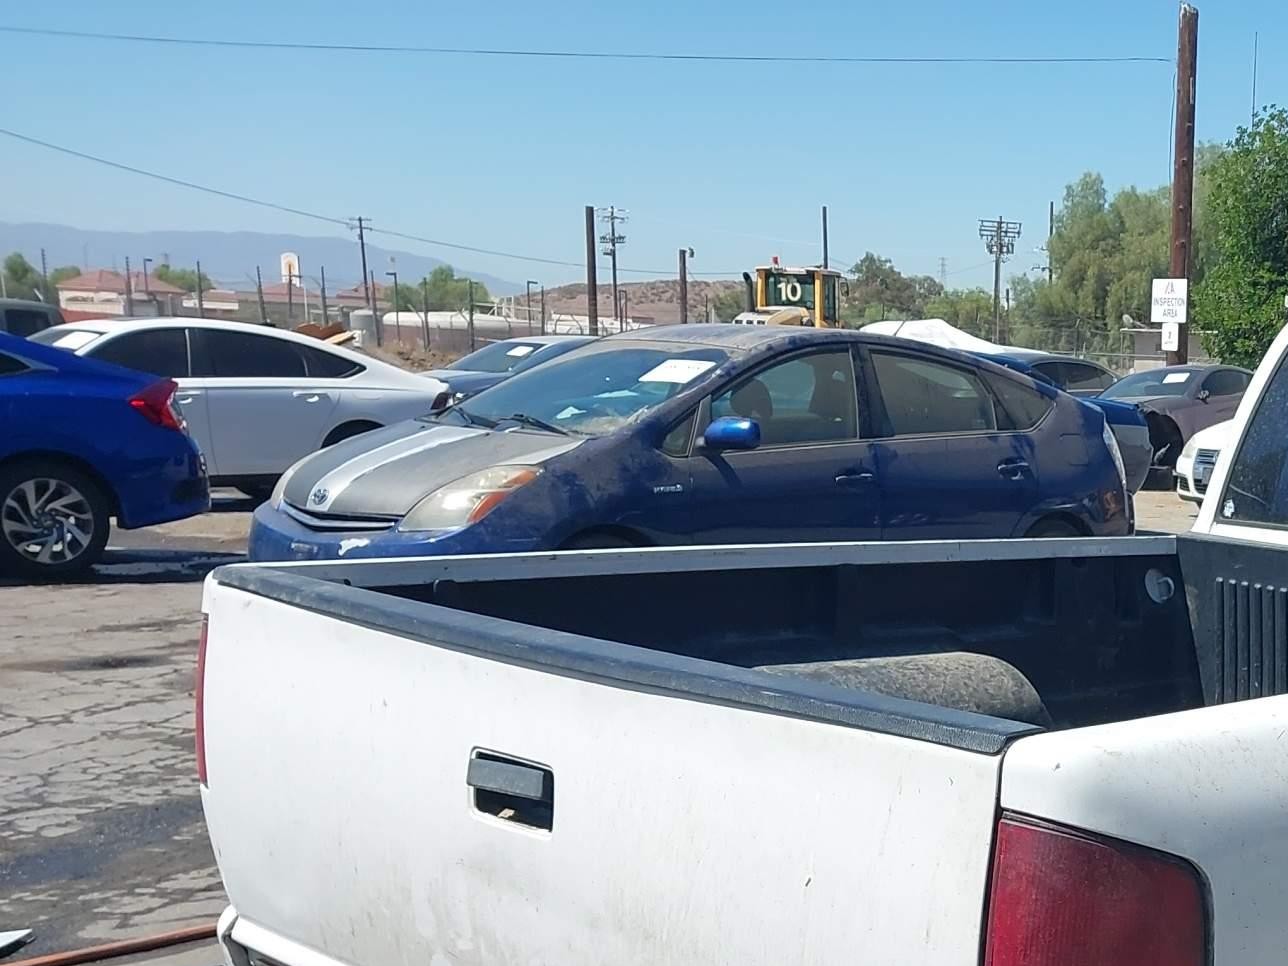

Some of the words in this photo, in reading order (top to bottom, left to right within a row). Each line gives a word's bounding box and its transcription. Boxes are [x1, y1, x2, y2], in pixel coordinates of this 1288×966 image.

[777, 282, 801, 301] 10
[1153, 297, 1185, 307] INSPECTION
[1162, 308, 1178, 318] AREA
